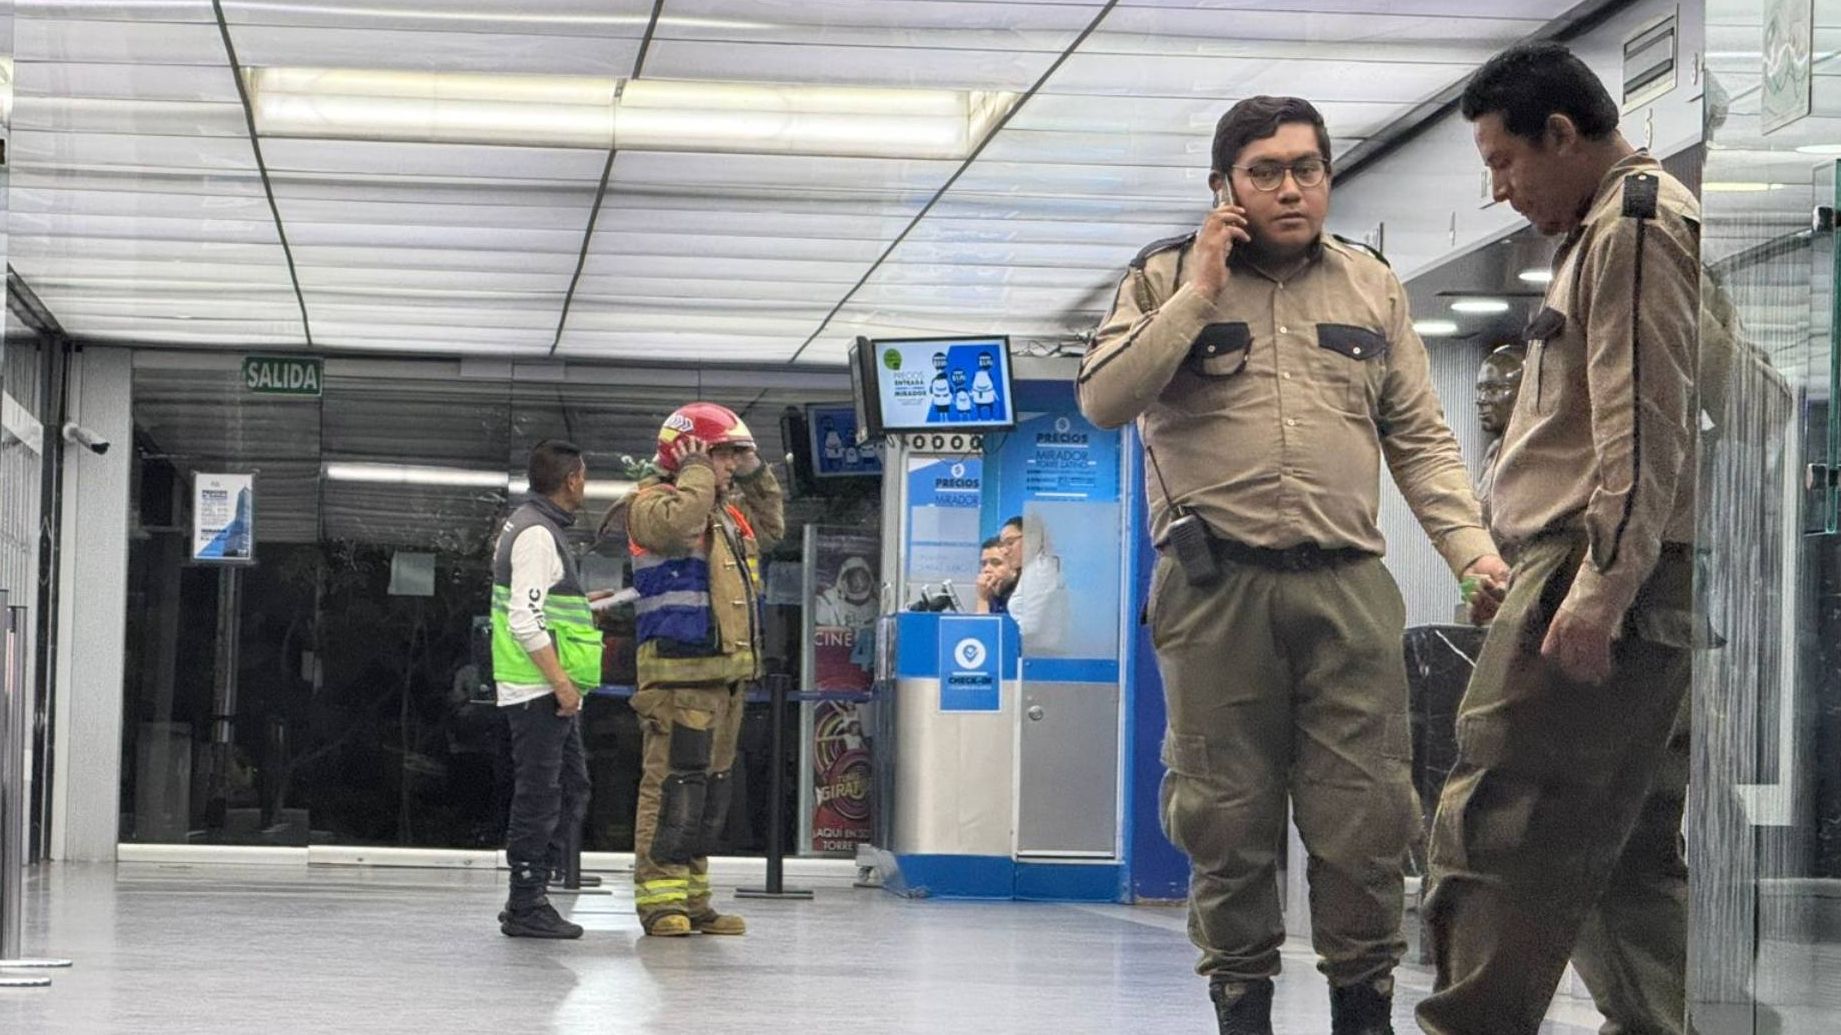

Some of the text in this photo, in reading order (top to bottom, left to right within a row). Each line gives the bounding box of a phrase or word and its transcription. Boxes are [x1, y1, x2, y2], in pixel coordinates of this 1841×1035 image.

[247, 361, 318, 389] SALIDA
[1036, 432, 1089, 443] PRECIOS
[1036, 450, 1089, 461] MIRADOR
[935, 478, 980, 488] PRECIOS
[814, 632, 853, 647] CINE
